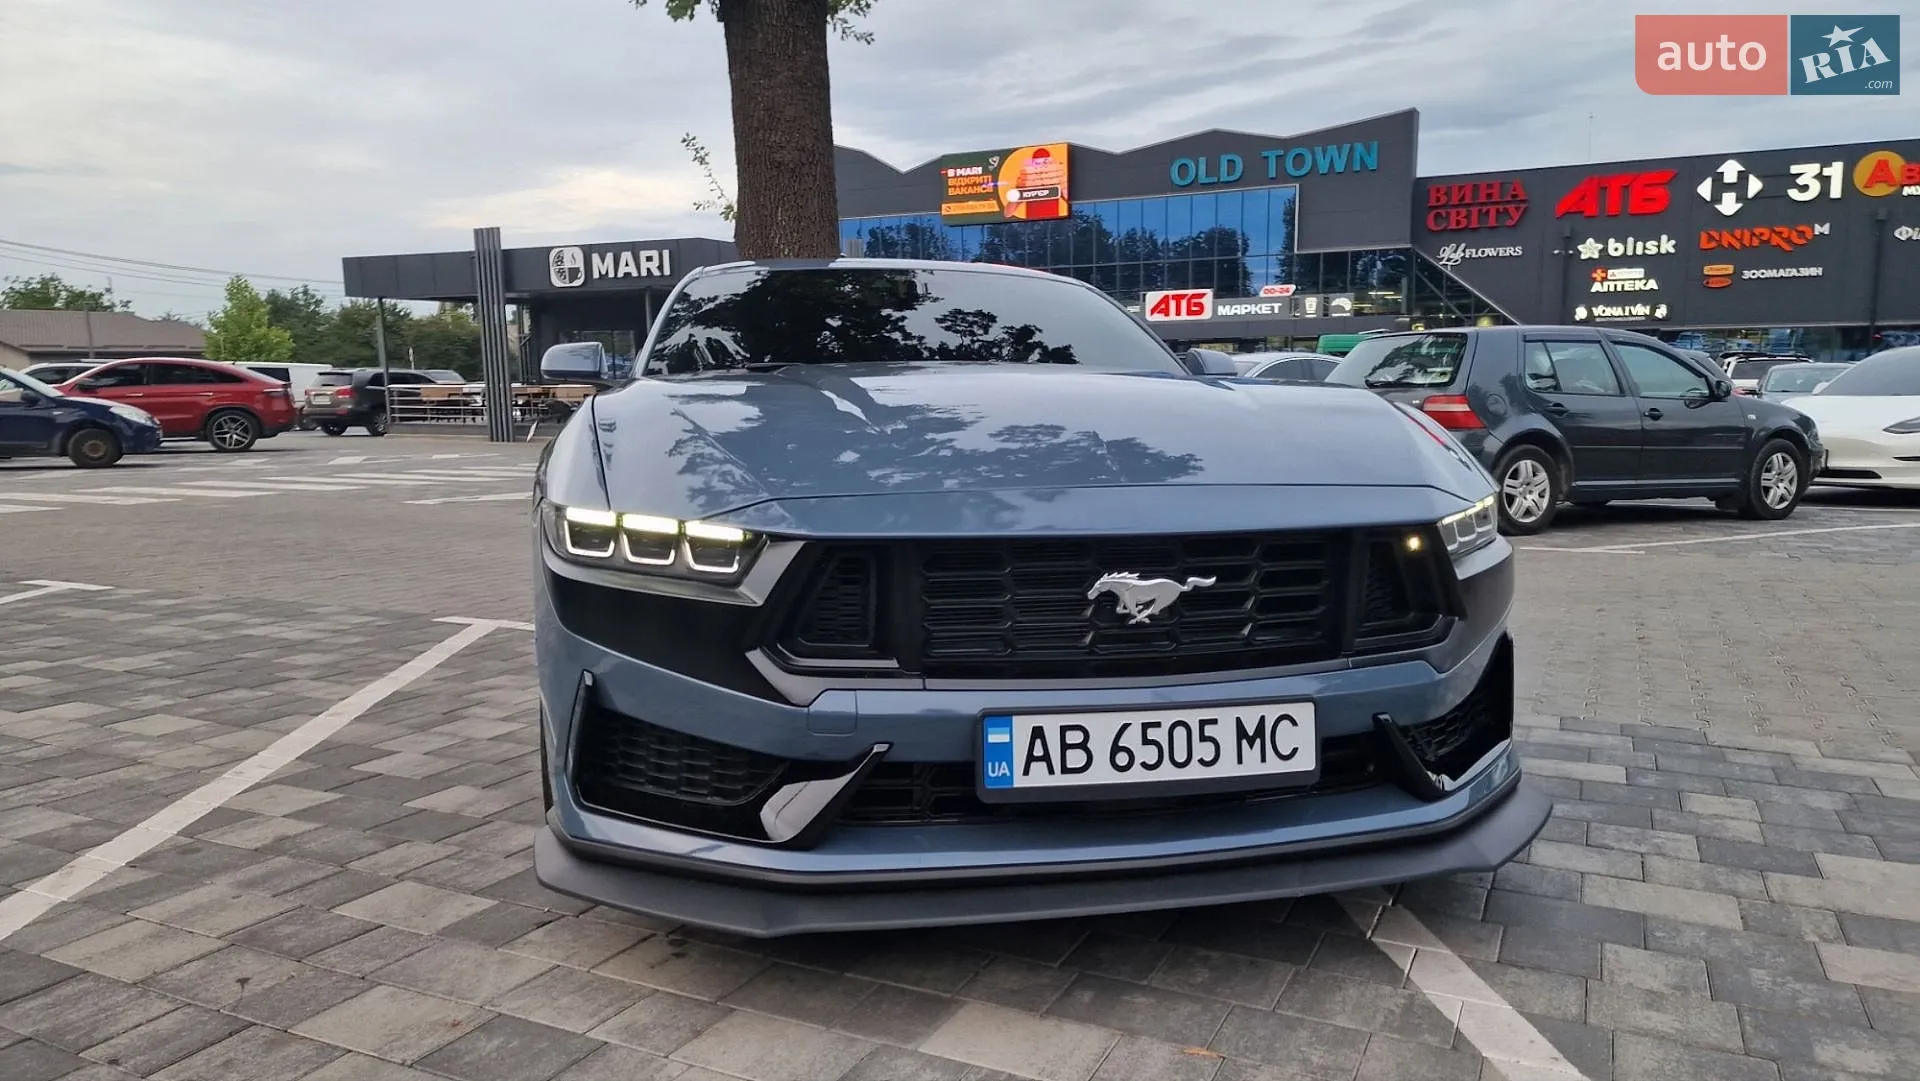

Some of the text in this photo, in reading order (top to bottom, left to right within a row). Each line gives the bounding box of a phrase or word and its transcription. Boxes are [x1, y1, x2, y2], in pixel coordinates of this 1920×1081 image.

[1170, 141, 1379, 186] OLD TOWN
[1427, 179, 1528, 206] ВИНА
[1555, 171, 1678, 218] АТБ
[1786, 161, 1844, 202] 31
[1426, 203, 1529, 232] СВІТУ
[591, 249, 671, 279] MARI
[1465, 246, 1523, 258] FLOWERS
[1590, 279, 1659, 293] АПТЕКА
[1741, 267, 1823, 280] ЗООМАГАЗИН
[1150, 293, 1208, 317] АТБ
[1217, 303, 1282, 316] МАРКЕТ
[1021, 713, 1299, 777] AB 6505 MC
[988, 761, 1010, 778] UA
